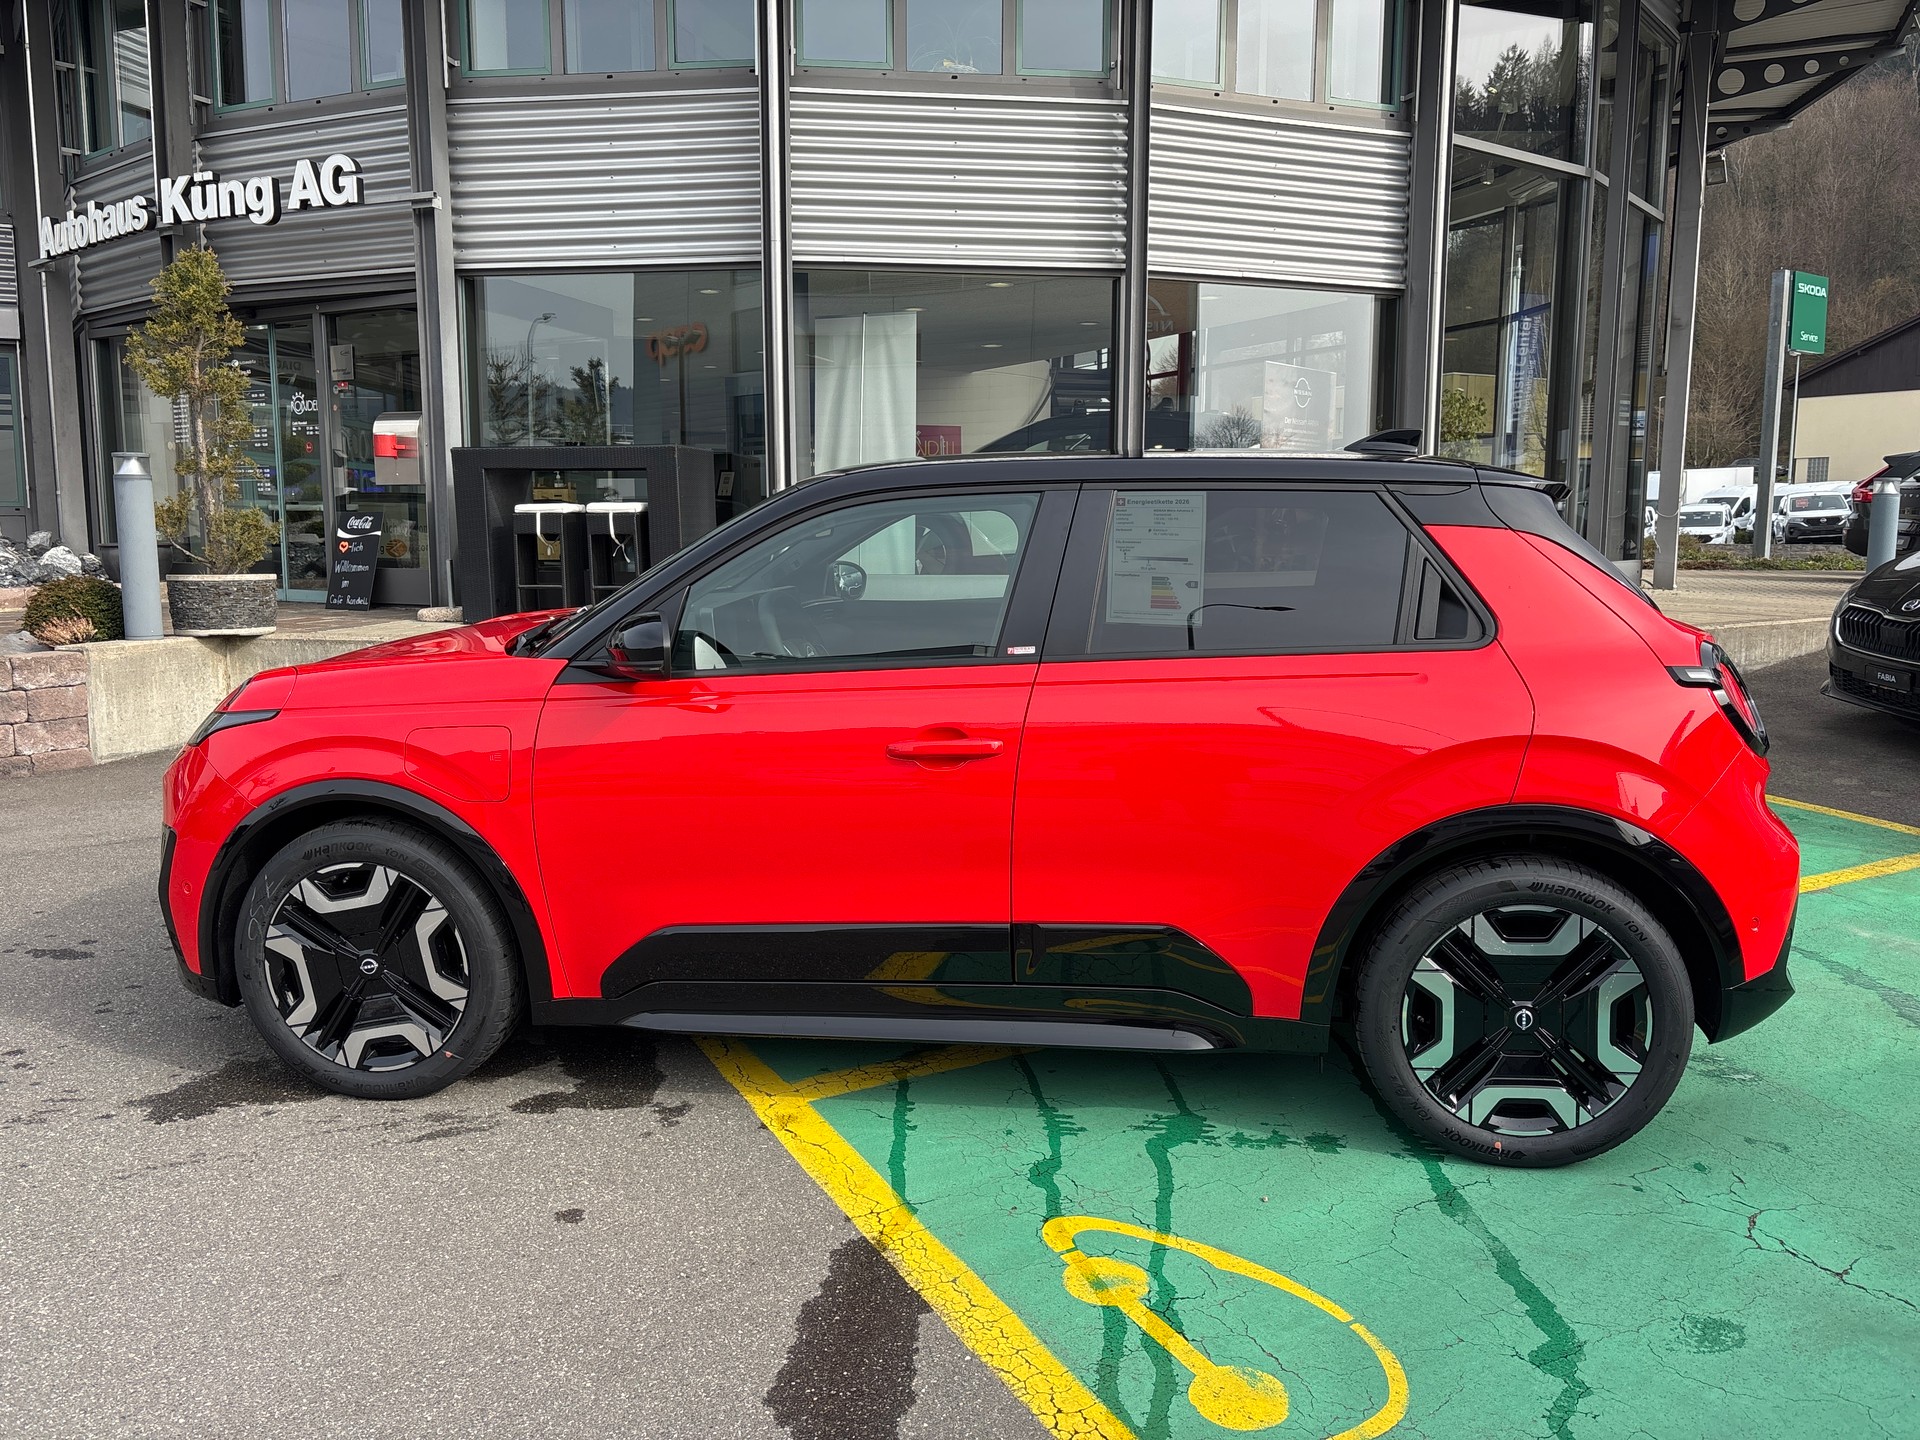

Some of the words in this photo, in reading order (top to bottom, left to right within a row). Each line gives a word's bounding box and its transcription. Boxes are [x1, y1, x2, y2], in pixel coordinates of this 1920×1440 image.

[40, 194, 152, 259] Autohaus
[160, 171, 277, 225] Küng
[287, 154, 361, 210] AG
[1517, 315, 1532, 366] Center
[1800, 331, 1819, 342] Service
[1877, 672, 1896, 683] FABIA
